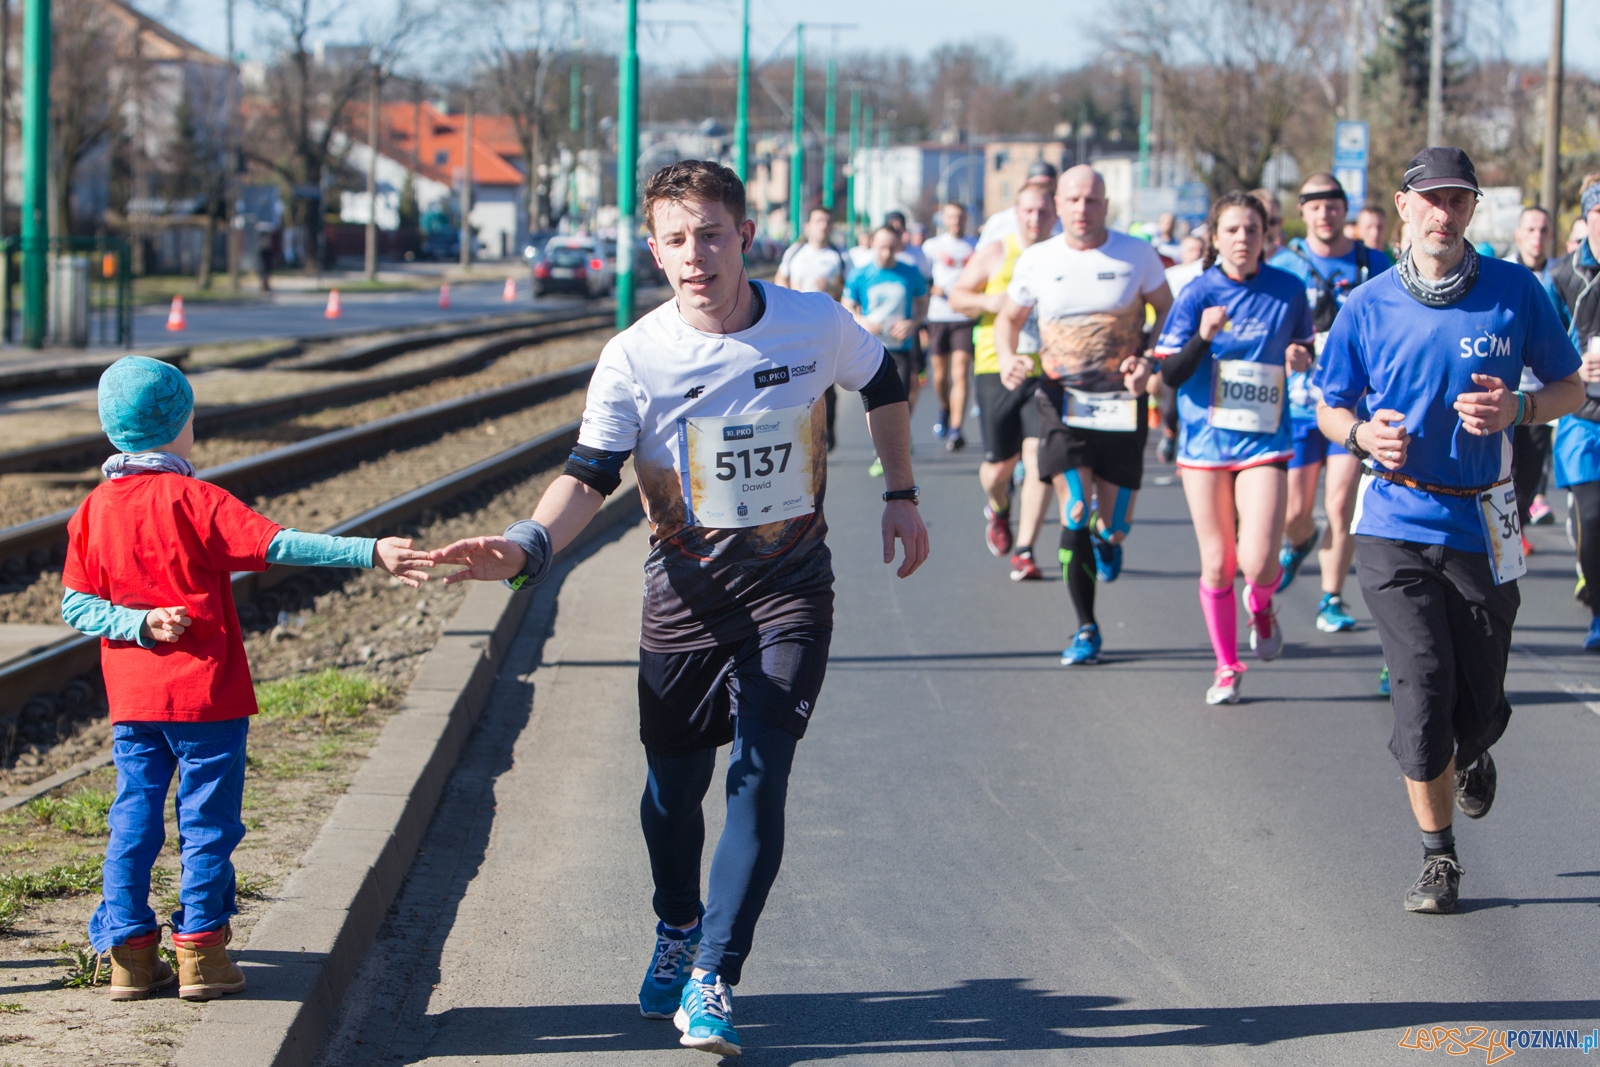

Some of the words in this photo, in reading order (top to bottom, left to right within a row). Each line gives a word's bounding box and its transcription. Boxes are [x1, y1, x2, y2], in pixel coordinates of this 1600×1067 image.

[769, 371, 787, 381] PKO
[683, 385, 706, 399] 4F
[1221, 381, 1280, 404] 10888
[736, 428, 752, 437] PKO
[715, 442, 792, 481] 5137
[742, 480, 772, 492] Dawid
